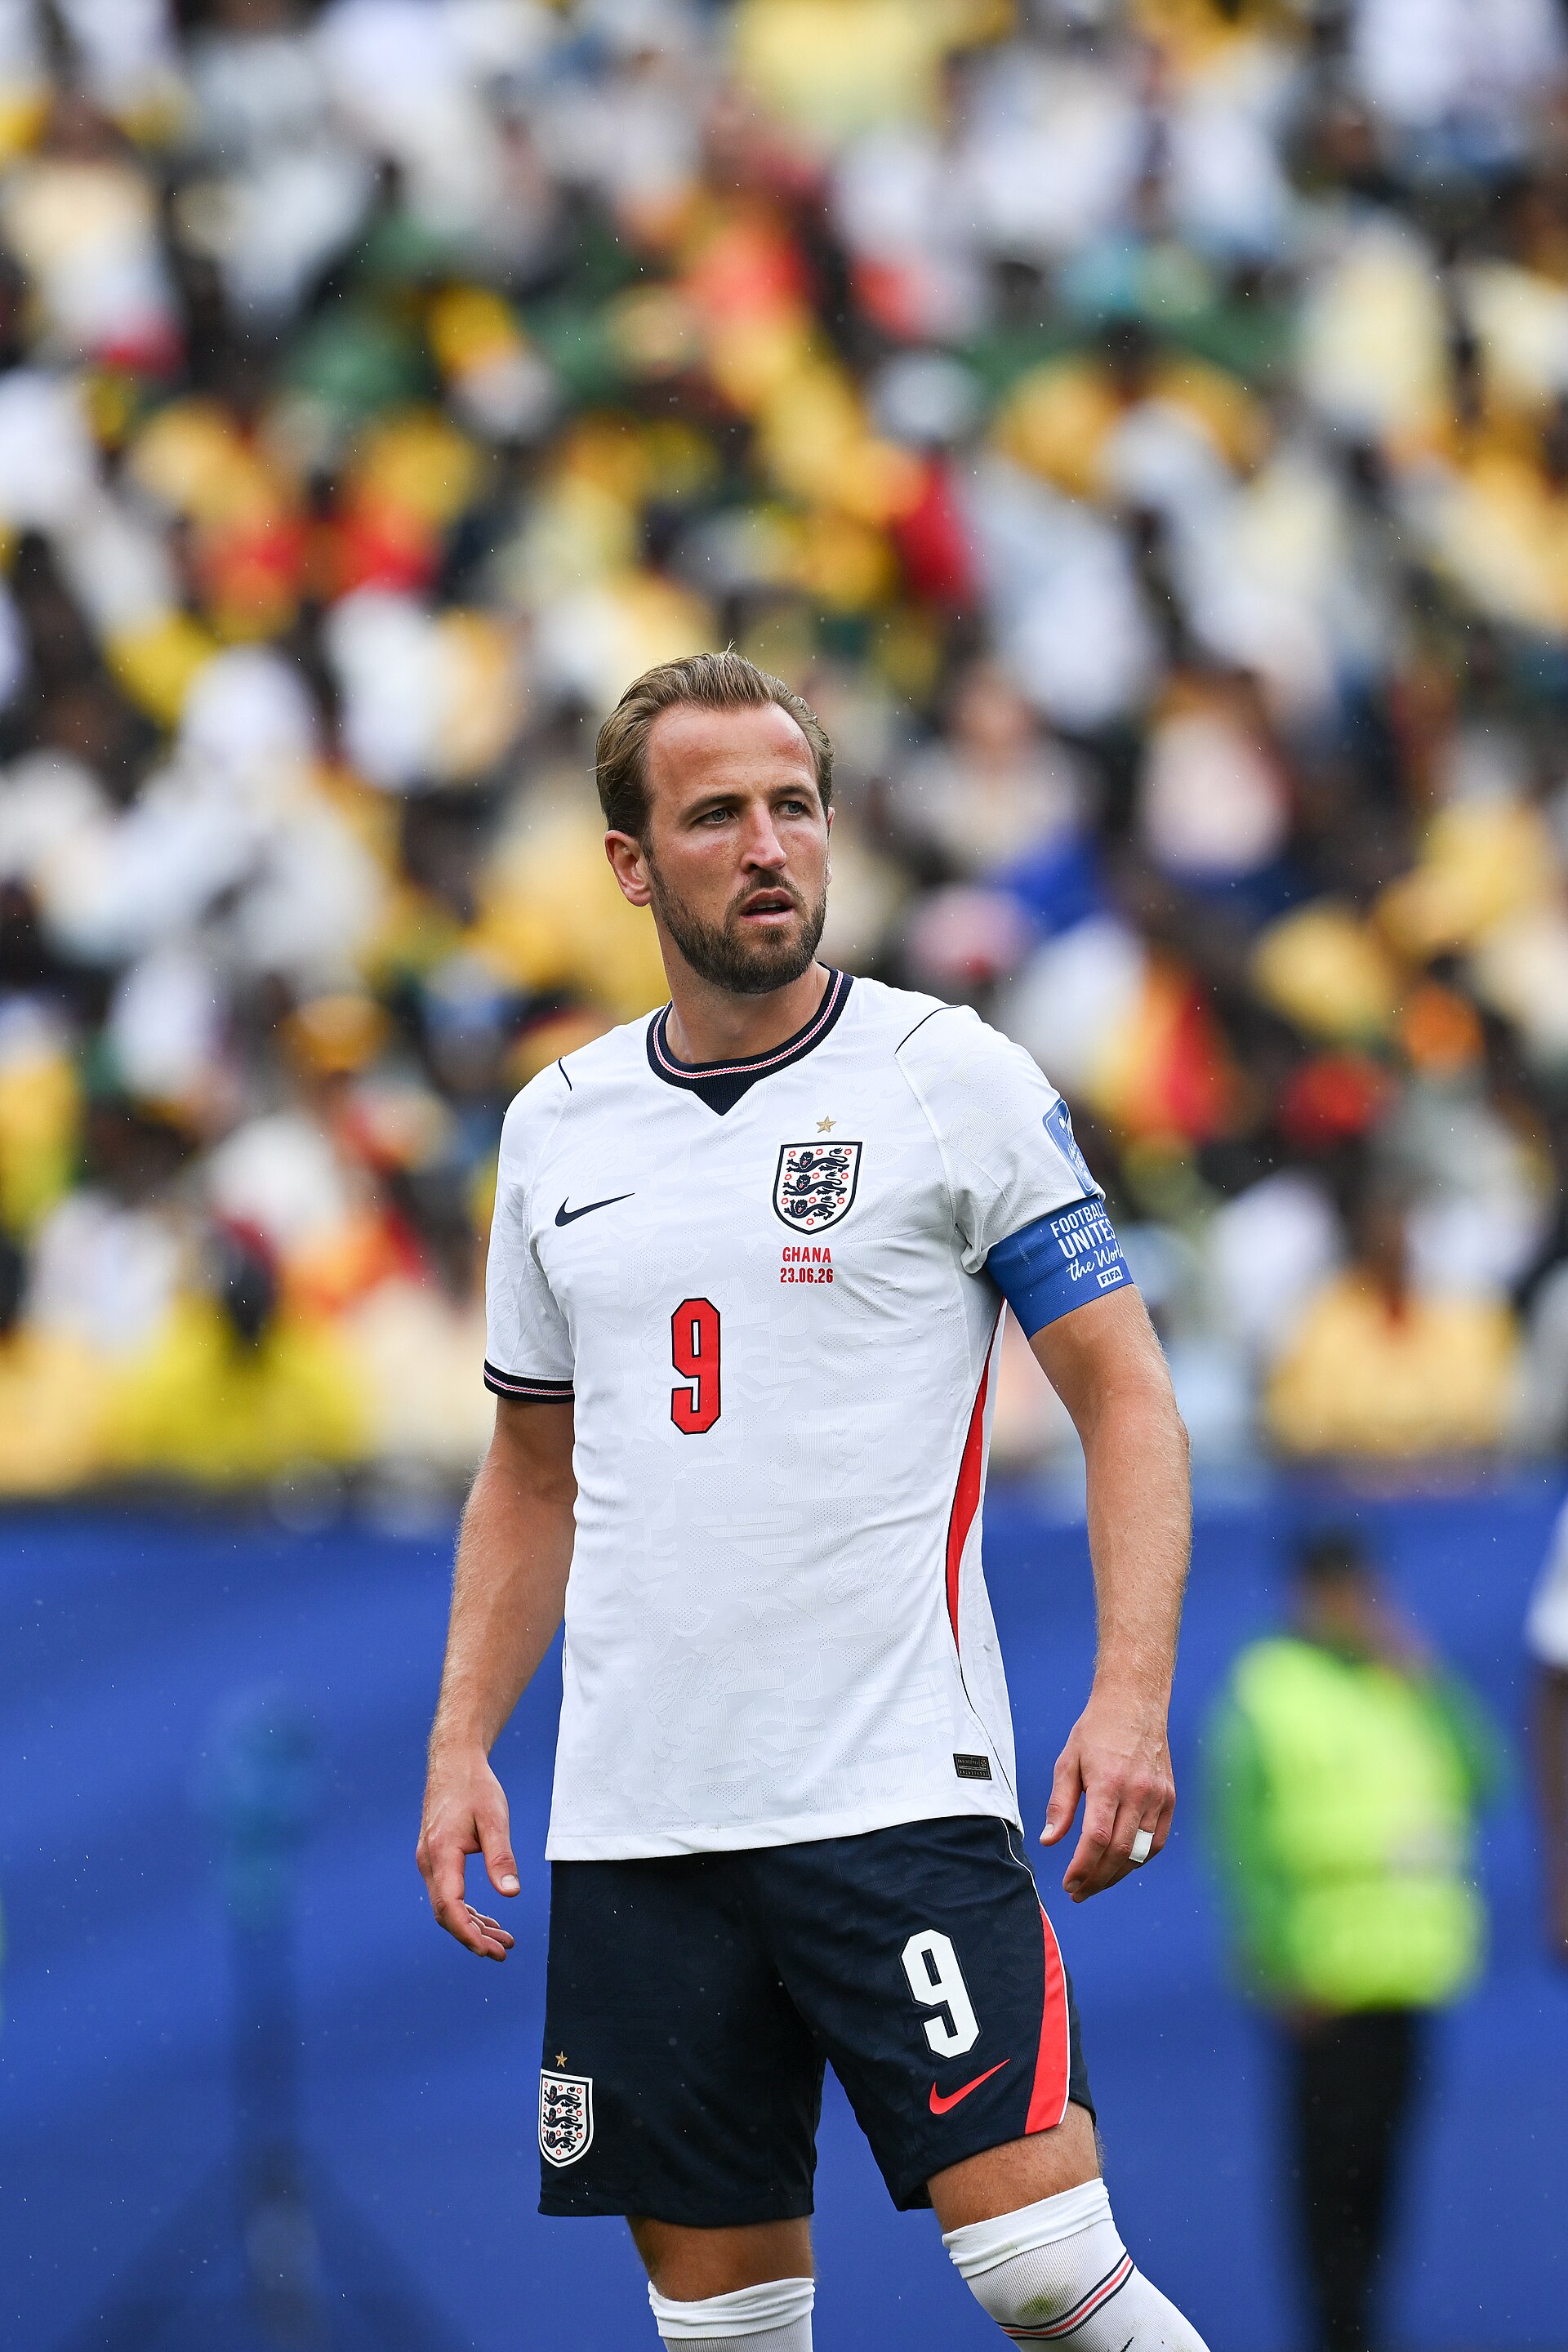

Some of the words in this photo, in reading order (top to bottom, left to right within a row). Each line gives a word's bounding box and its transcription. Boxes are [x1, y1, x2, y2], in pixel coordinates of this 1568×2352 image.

[1050, 1202, 1107, 1238] FOOTBALL
[1058, 1218, 1116, 1258] UNITES
[782, 1246, 831, 1263] GHANA
[780, 1267, 833, 1283] 23.06.26
[1066, 1258, 1094, 1281] the
[1099, 1269, 1121, 1285] FIFA
[670, 1298, 721, 1435] 9
[901, 1928, 981, 2059] 9
